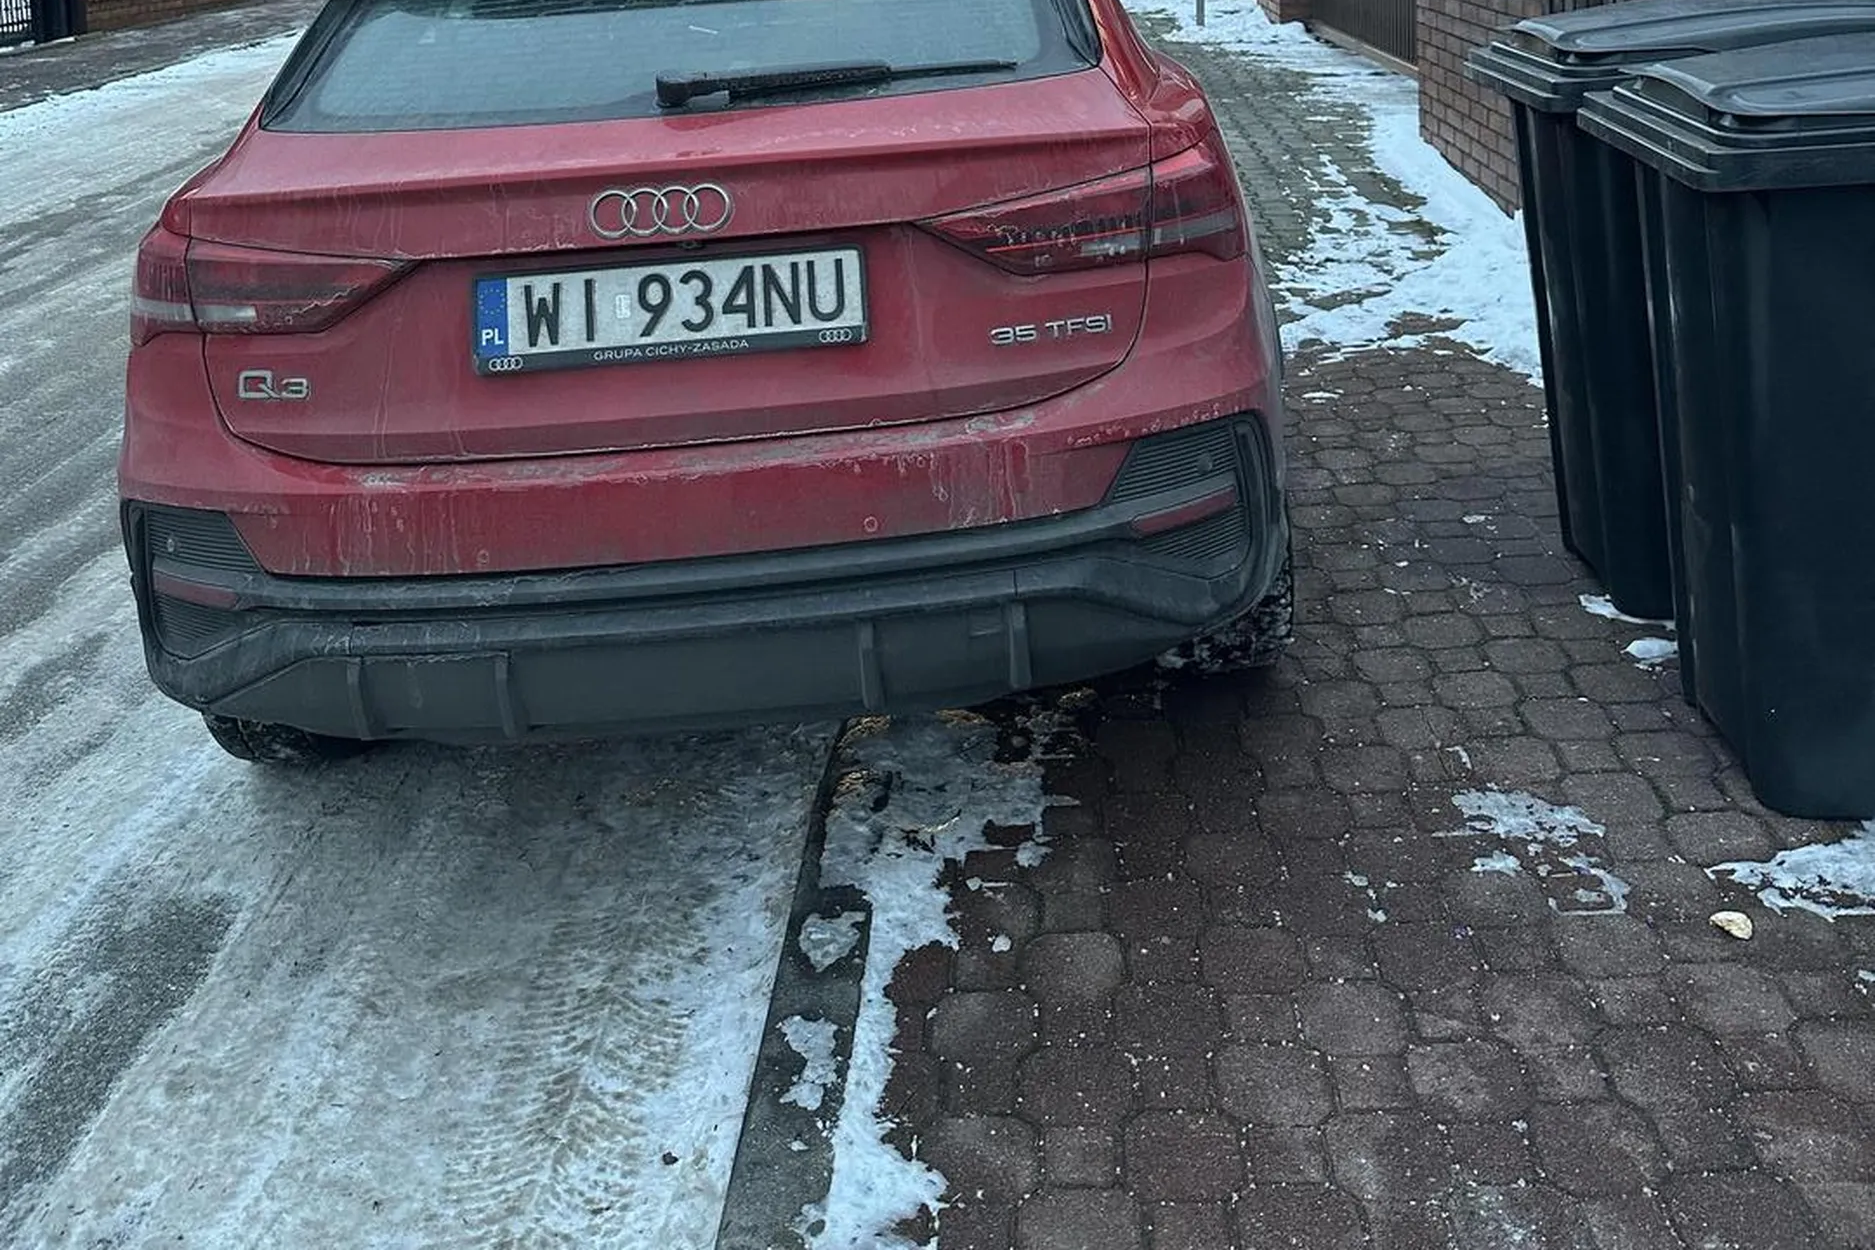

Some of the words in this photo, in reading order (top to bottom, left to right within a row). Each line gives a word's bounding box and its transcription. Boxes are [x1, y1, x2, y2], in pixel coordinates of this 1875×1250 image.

[524, 278, 597, 348] WI
[637, 258, 845, 338] 934NU
[481, 327, 504, 346] PL
[990, 324, 1038, 346] 35
[1045, 314, 1112, 338] TFSI
[593, 350, 643, 361] GRUPA
[645, 339, 750, 357] CICHY-ZASADA
[239, 369, 309, 400] Q3
